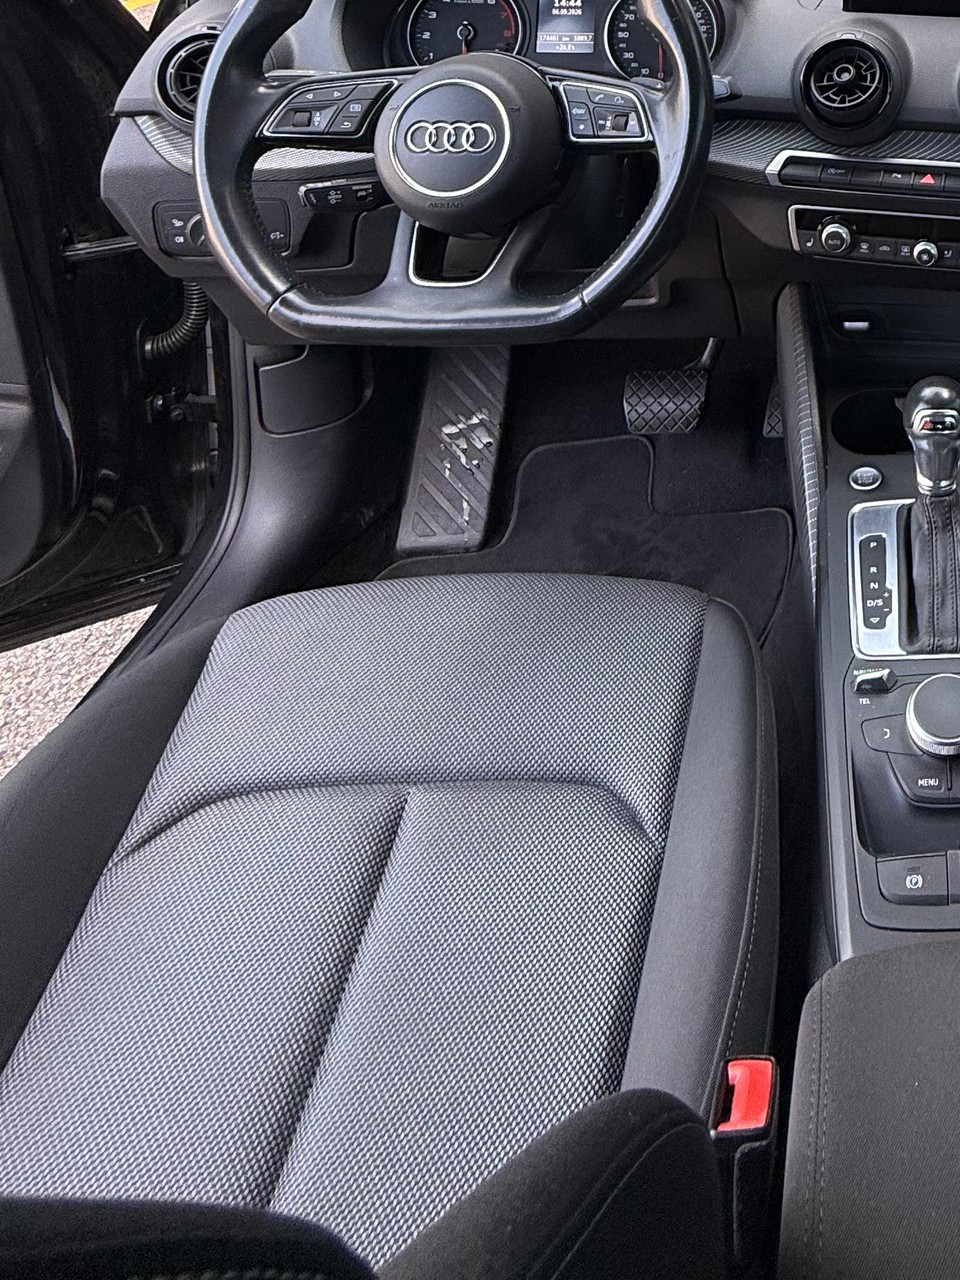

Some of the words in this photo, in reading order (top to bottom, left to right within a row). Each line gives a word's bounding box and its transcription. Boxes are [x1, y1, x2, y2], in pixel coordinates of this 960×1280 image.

[428, 11, 437, 19] 3
[422, 31, 431, 39] 2
[428, 52, 434, 60] 1
[866, 599, 884, 607] D/S
[858, 697, 871, 705] TEL
[917, 778, 939, 787] MENU
